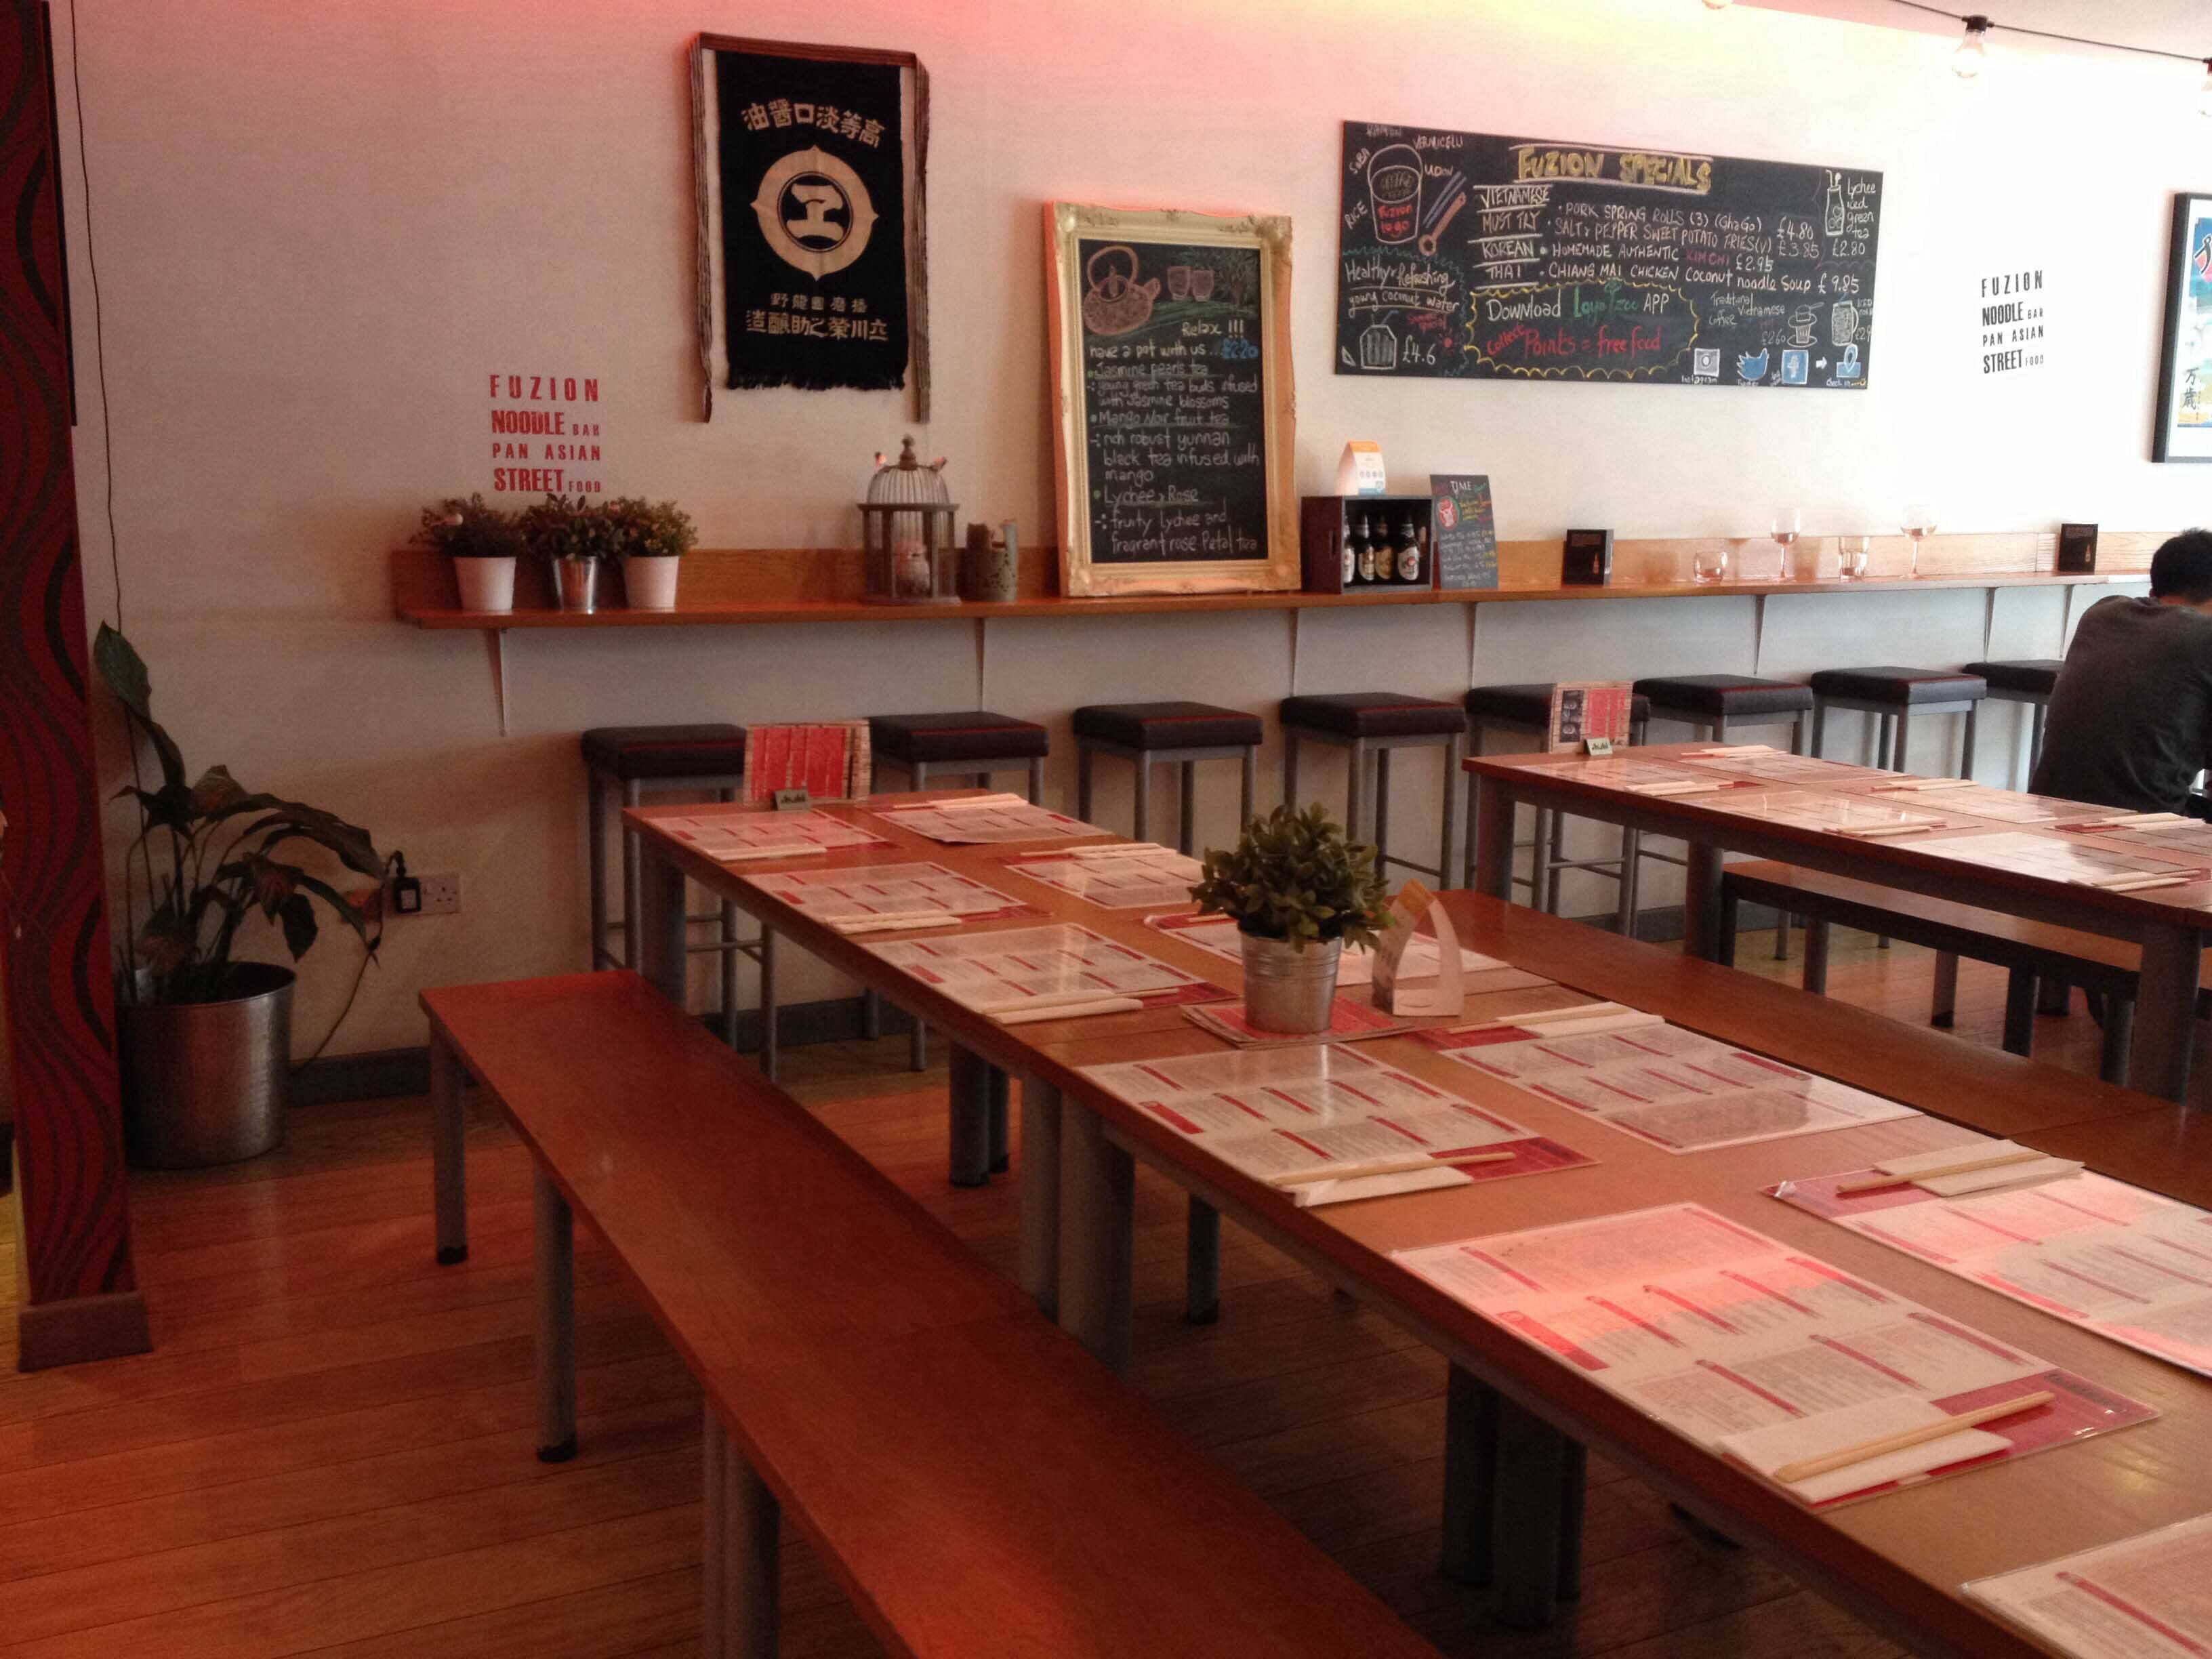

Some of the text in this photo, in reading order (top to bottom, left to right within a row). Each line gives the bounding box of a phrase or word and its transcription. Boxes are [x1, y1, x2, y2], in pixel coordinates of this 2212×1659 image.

[1425, 163, 1454, 177] UDON
[1519, 147, 1713, 192] FUZION SPECIALS
[1480, 186, 1550, 208] VIETNAMESE
[1483, 211, 1540, 233] MUST TRY
[1566, 203, 1599, 218] PORK
[1605, 205, 1647, 222] SPRING
[1653, 207, 1685, 226] ROLLS
[1555, 218, 1582, 237] SALT
[1595, 221, 1637, 241] PEPPER
[1643, 224, 1677, 242] SWEET
[1682, 229, 1718, 248] POTATO
[1482, 239, 1534, 259] KOREAN
[1618, 244, 1679, 262] AUTHENTIC
[1549, 262, 1595, 278] CHIANG
[1599, 263, 1621, 276] MAI
[1631, 264, 1679, 281] CHICKEN
[1982, 270, 2043, 298] FUZION
[1643, 293, 1669, 314] APP
[1982, 302, 2043, 326] NOODLE BAR
[1983, 325, 2043, 347] PAN ASIAN
[1984, 349, 2044, 373] STREET FOOD
[490, 374, 598, 401] FUZION
[491, 410, 600, 436] NOODLE BAR
[493, 443, 600, 461] PAN ASIAN
[494, 468, 600, 492] STREET FOOD
